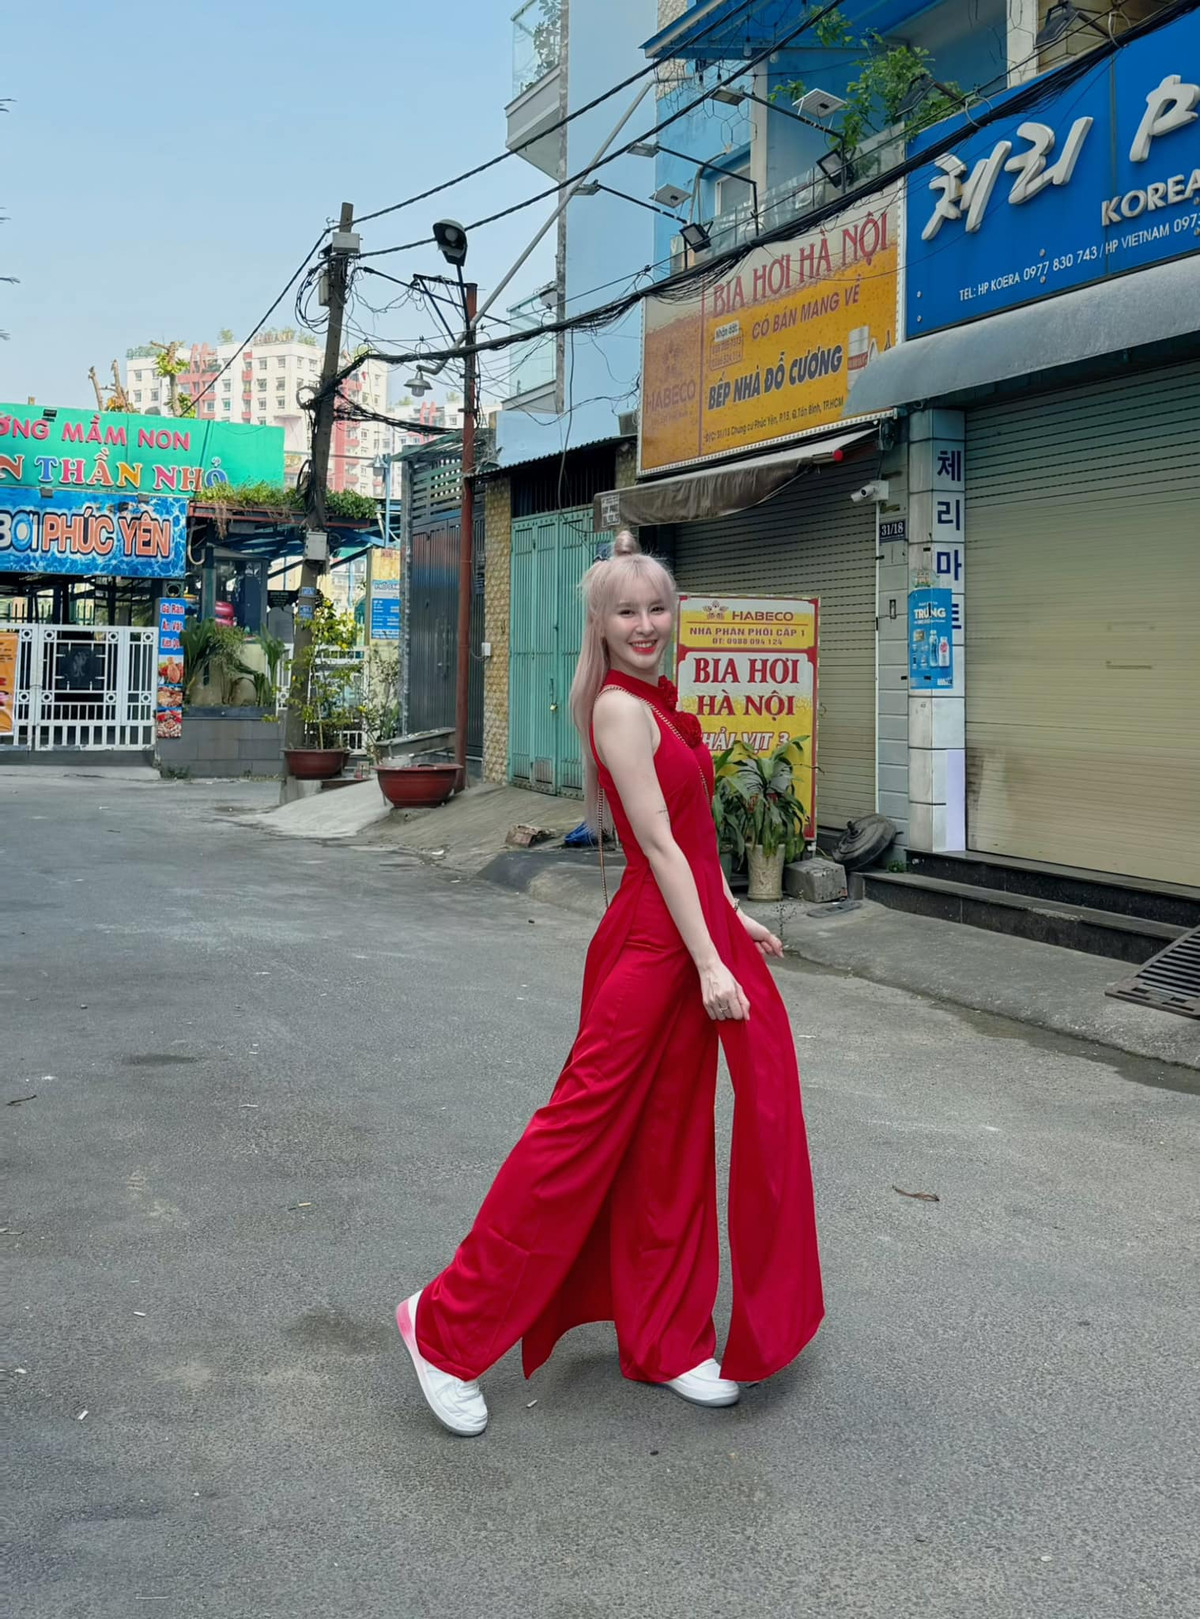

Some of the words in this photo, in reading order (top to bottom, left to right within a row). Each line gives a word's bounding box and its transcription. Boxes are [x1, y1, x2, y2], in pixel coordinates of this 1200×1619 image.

[713, 276, 745, 318] BIA
[753, 256, 791, 300] HƠI
[799, 230, 832, 283] HÀ
[842, 210, 888, 266] NỘI
[960, 288, 976, 301] TEL:
[978, 281, 988, 296] HP
[991, 272, 1020, 291] KOERA
[1023, 261, 1049, 280] 0977
[1053, 254, 1073, 272] 830
[1077, 246, 1098, 264] 743
[1105, 239, 1118, 254] HP
[1121, 223, 1169, 249] VIETNAM
[752, 313, 770, 340] CÓ
[773, 306, 797, 333] BÁN
[800, 292, 840, 322] MANG
[646, 380, 696, 413] HABECO
[708, 371, 731, 410] BẾP
[733, 365, 761, 403] NHÀ
[764, 351, 786, 393] ĐỖ
[62, 414, 127, 446] MẦM
[138, 428, 190, 451] NON
[34, 448, 143, 488] THẦN
[153, 457, 228, 492] NHỎ
[42, 507, 114, 555] PHÚC
[119, 515, 171, 557] YÊN
[881, 521, 904, 536] 31/18
[732, 611, 794, 621] HABECO
[693, 658, 740, 683] BIA
[747, 658, 800, 683] HƠI
[696, 689, 735, 716] HÀ
[743, 690, 795, 721] NỘI
